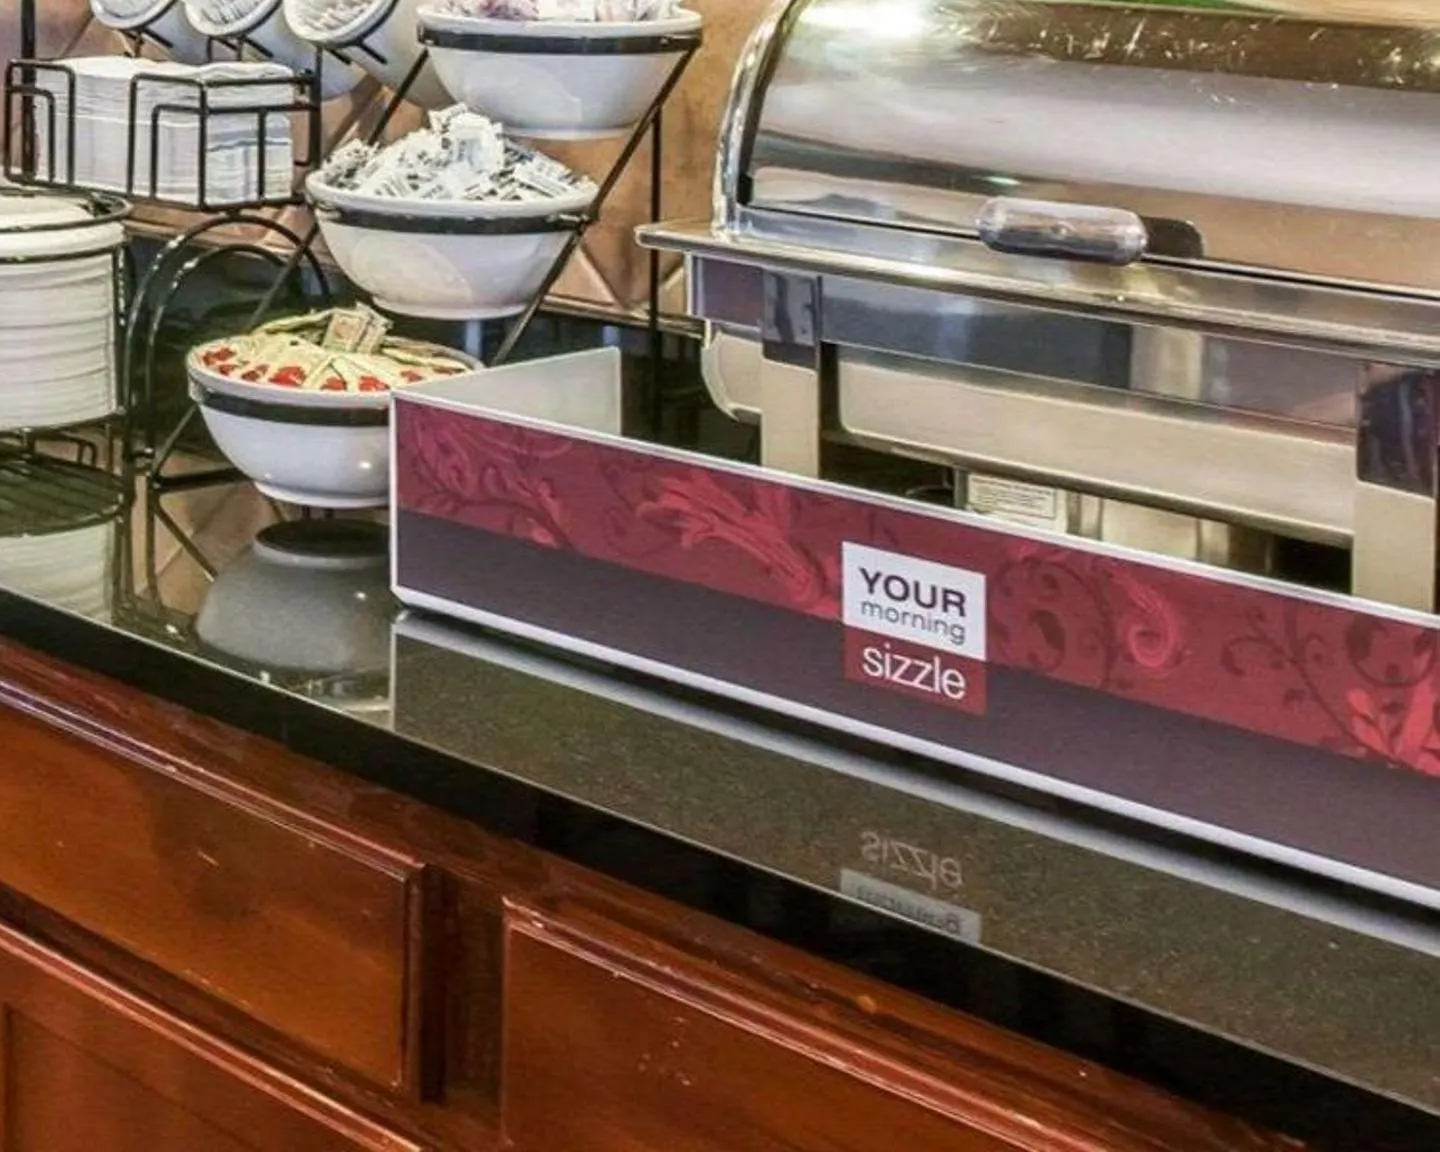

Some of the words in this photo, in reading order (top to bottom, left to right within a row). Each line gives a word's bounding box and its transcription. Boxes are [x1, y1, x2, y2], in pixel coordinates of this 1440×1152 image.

[859, 567, 967, 617] YOUR
[862, 599, 966, 646] morning
[862, 641, 967, 700] sizzle
